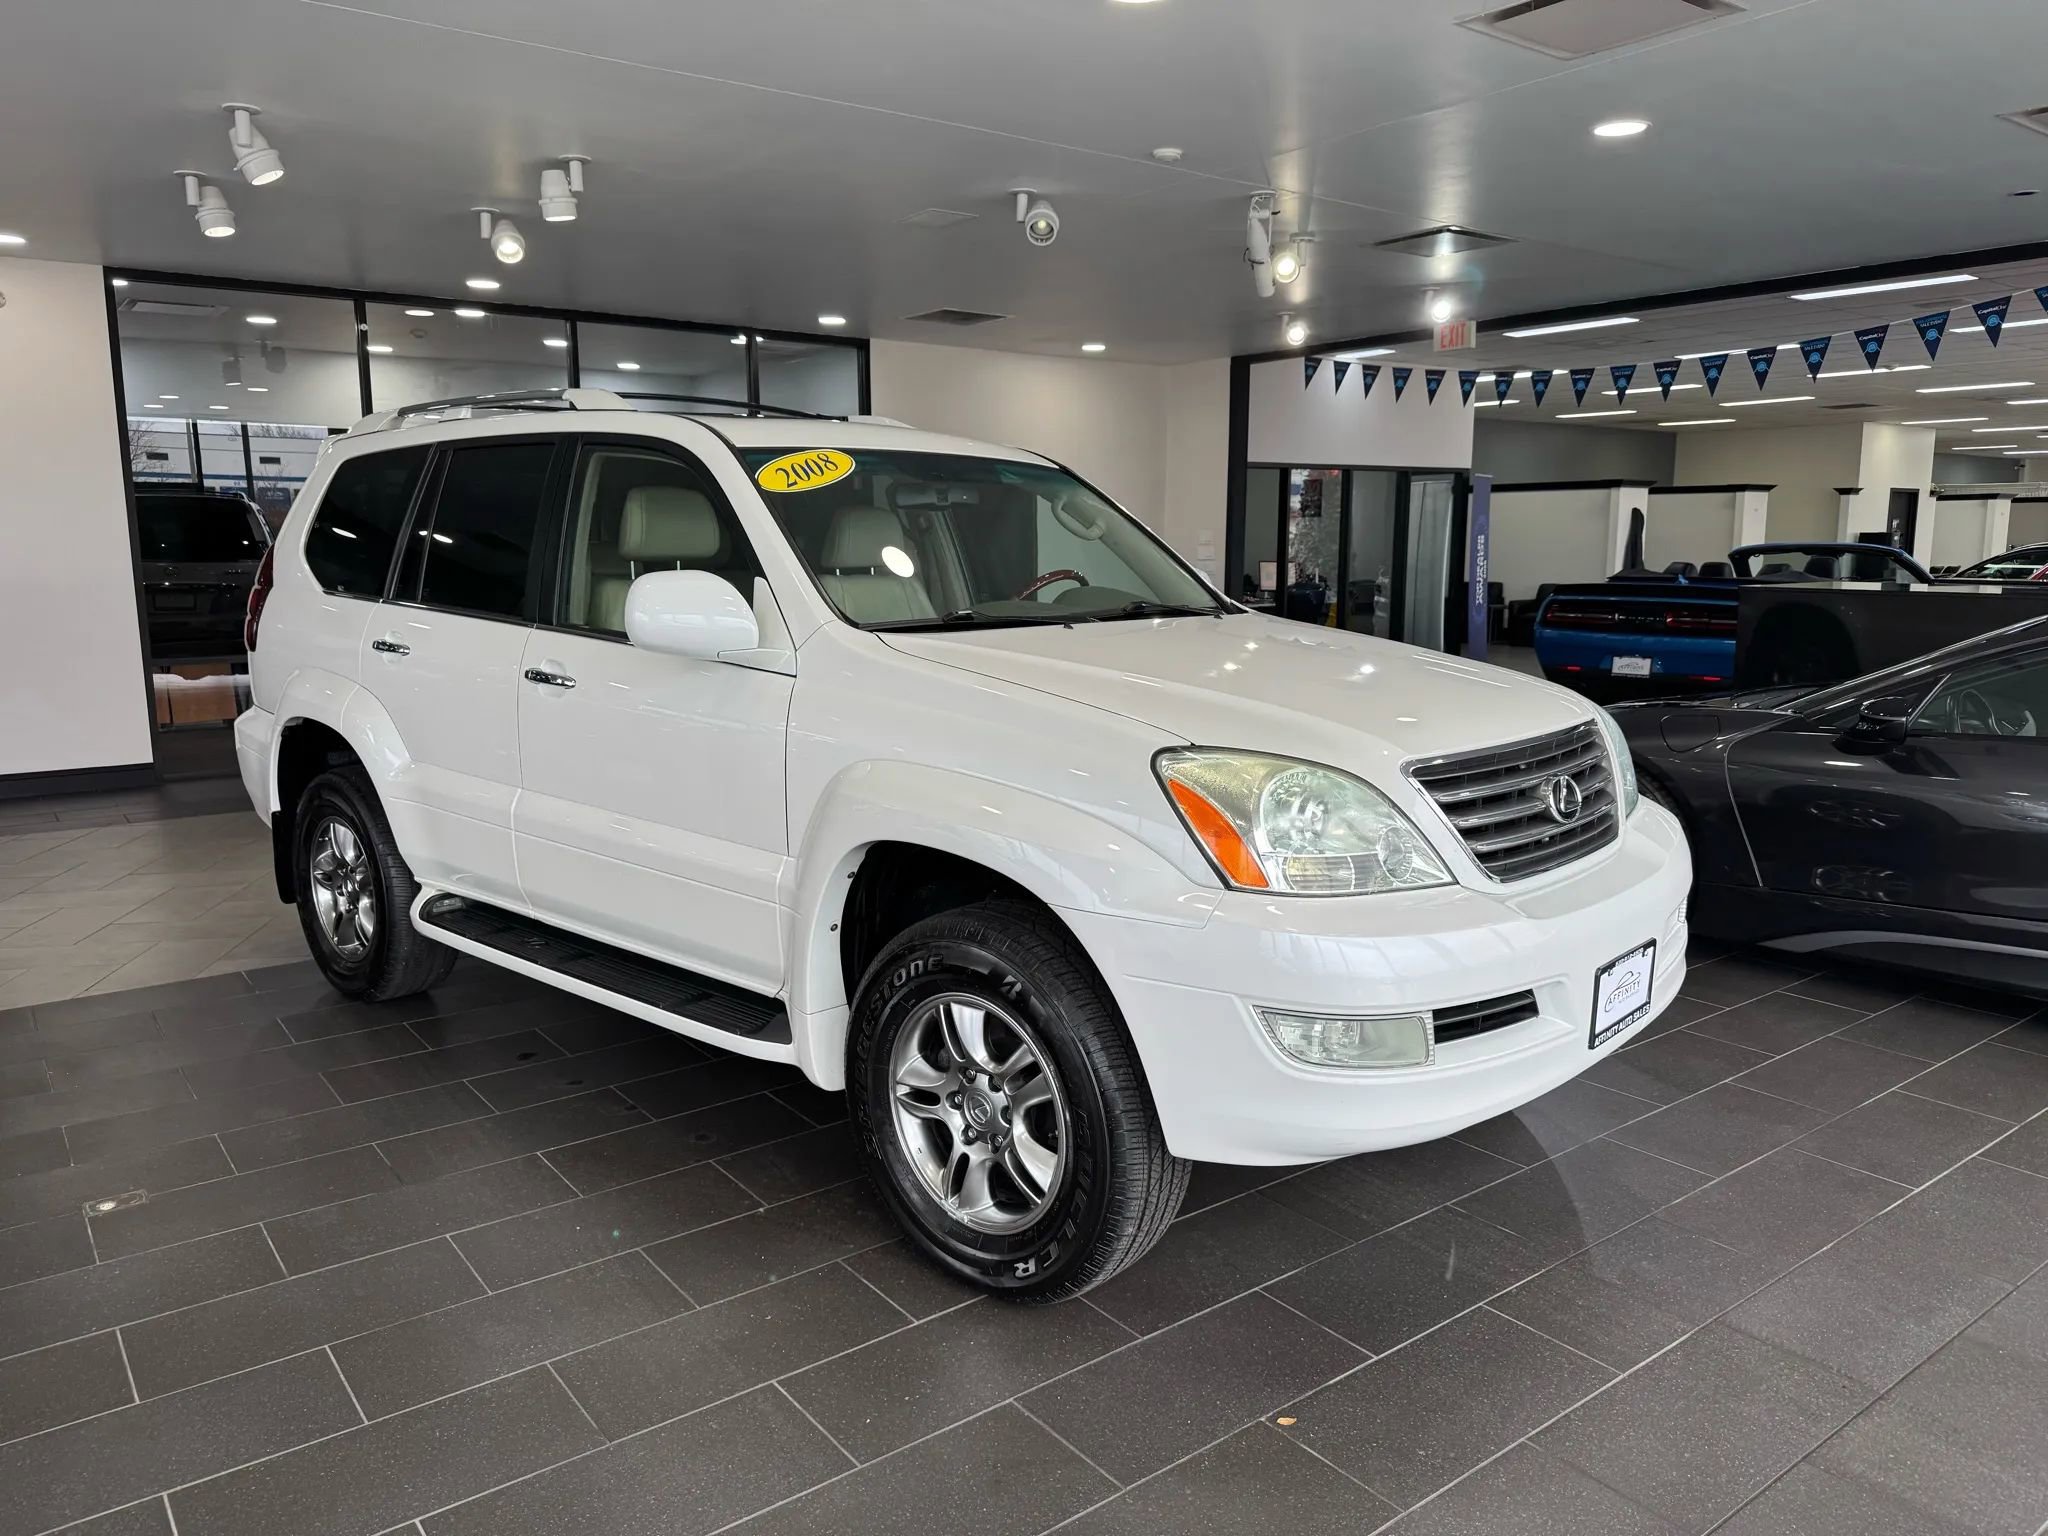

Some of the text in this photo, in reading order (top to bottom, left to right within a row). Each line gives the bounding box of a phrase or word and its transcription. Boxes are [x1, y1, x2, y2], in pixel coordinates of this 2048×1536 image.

[1440, 320, 1467, 351] EXIT
[775, 452, 839, 489] 2008
[1607, 979, 1641, 1005] AFFINITY
[1594, 1003, 1651, 1047] AFFINITY AUTO SALES
